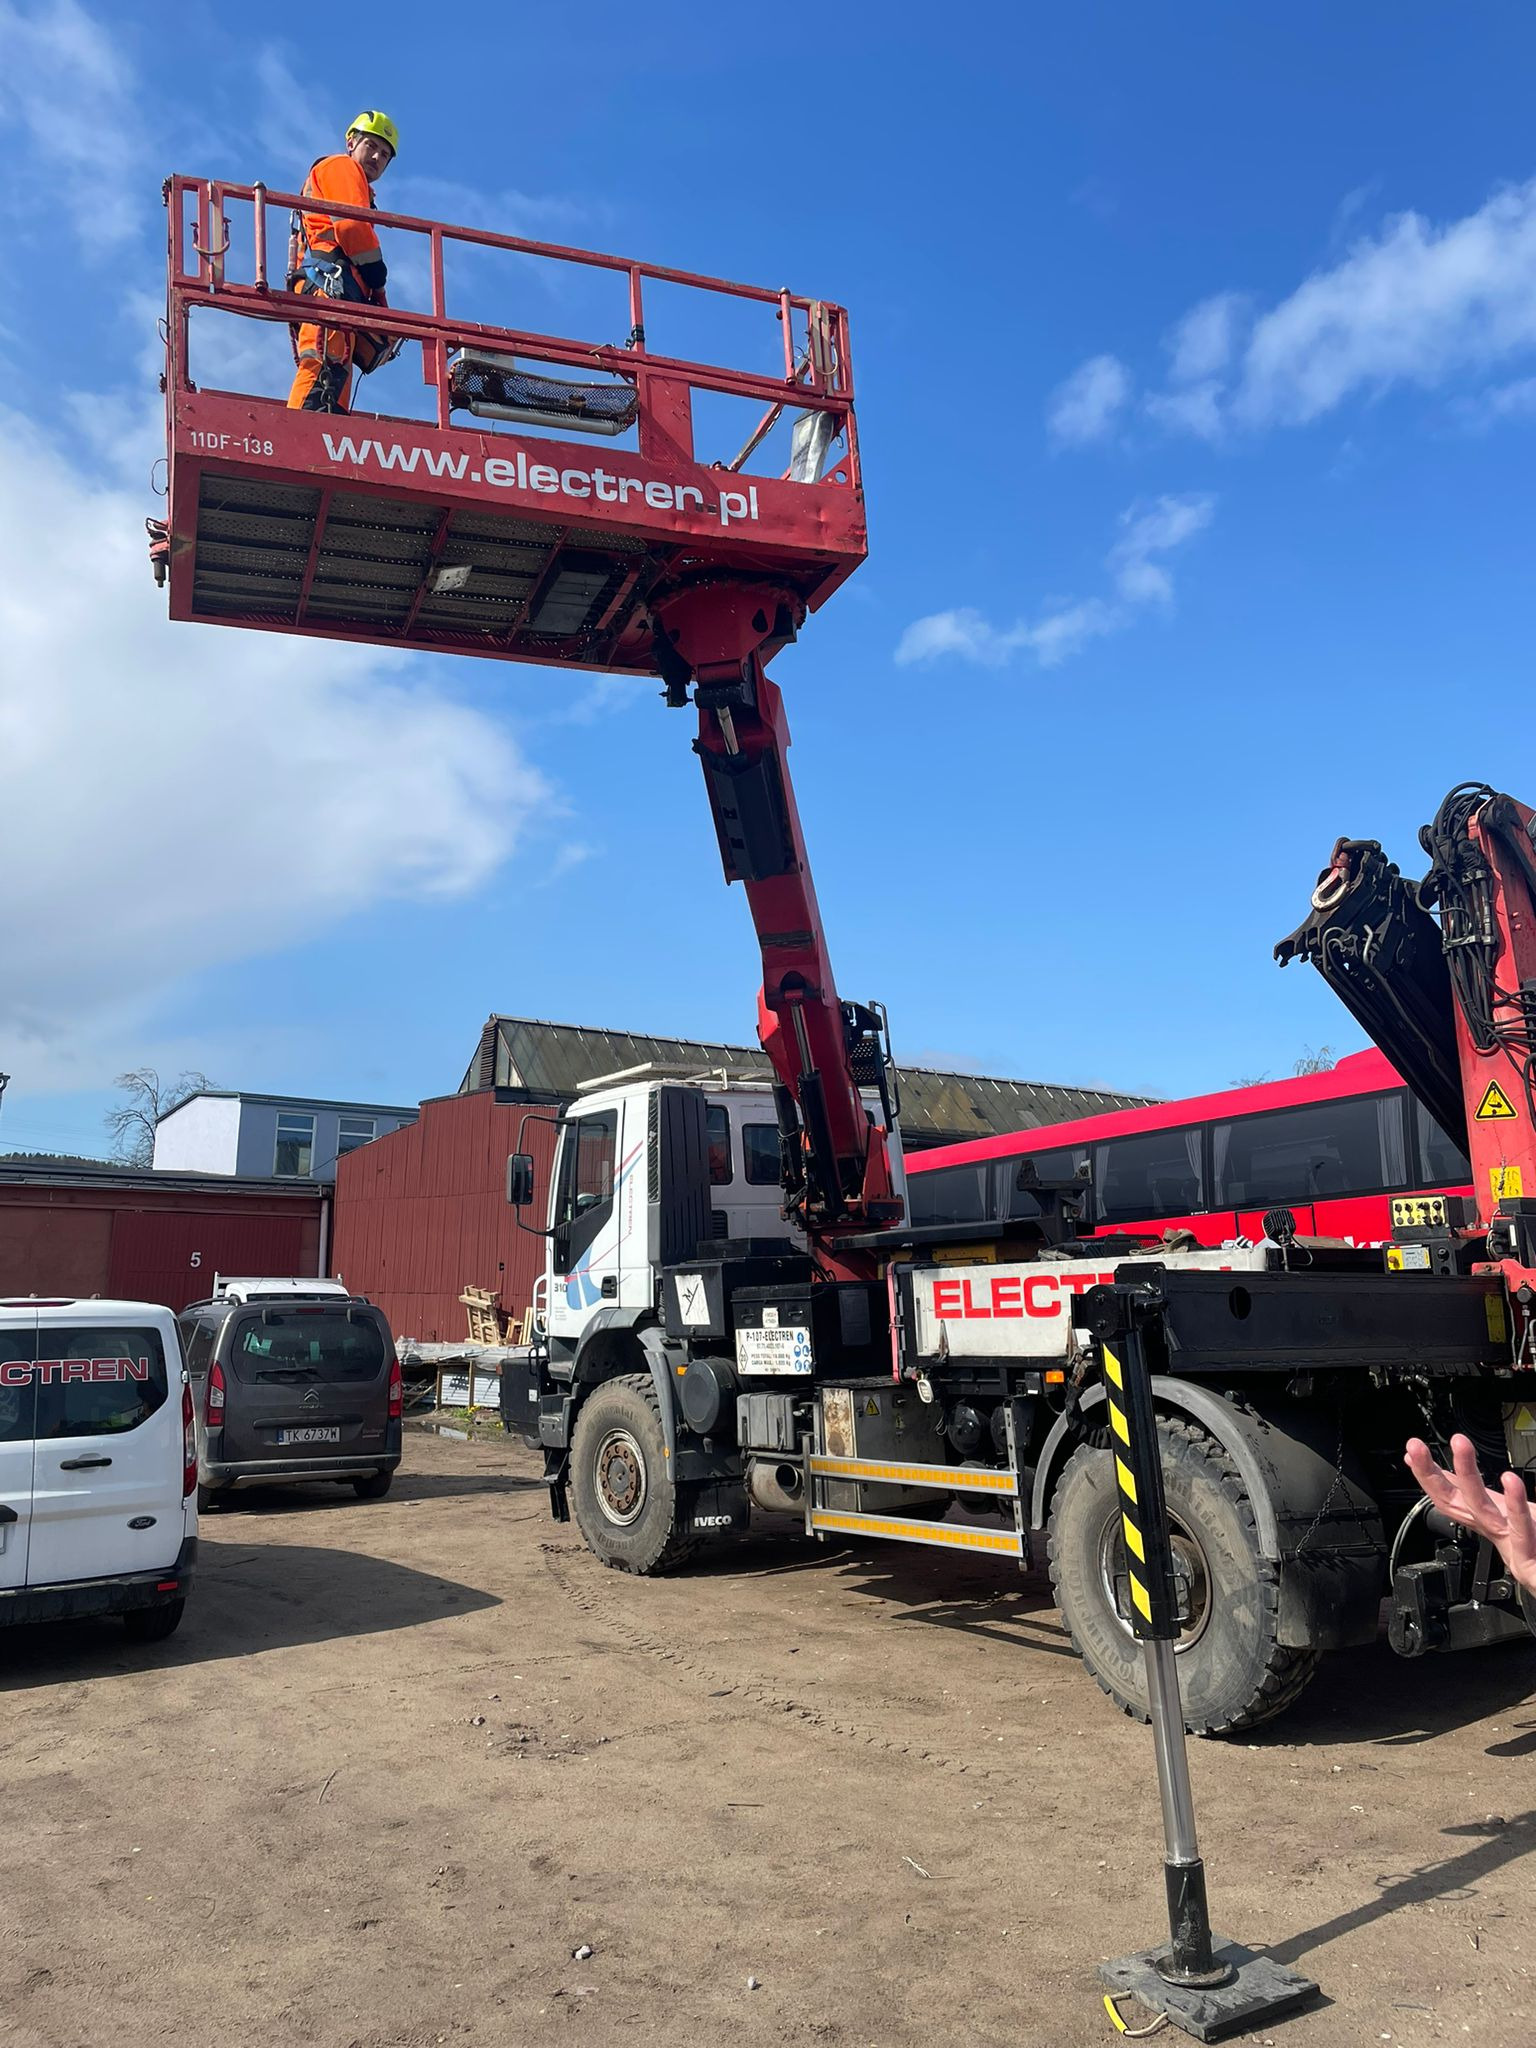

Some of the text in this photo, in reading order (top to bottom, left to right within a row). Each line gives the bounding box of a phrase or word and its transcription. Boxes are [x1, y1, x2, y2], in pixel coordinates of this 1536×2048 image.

[190, 431, 274, 456] 11DF-138
[321, 432, 759, 526] www.electren.pl
[190, 1252, 201, 1268] 5
[554, 1283, 568, 1292] 310
[0, 1357, 149, 1387] CTREN
[286, 1428, 338, 1441] TK 6737W
[694, 1515, 732, 1527] IVECO
